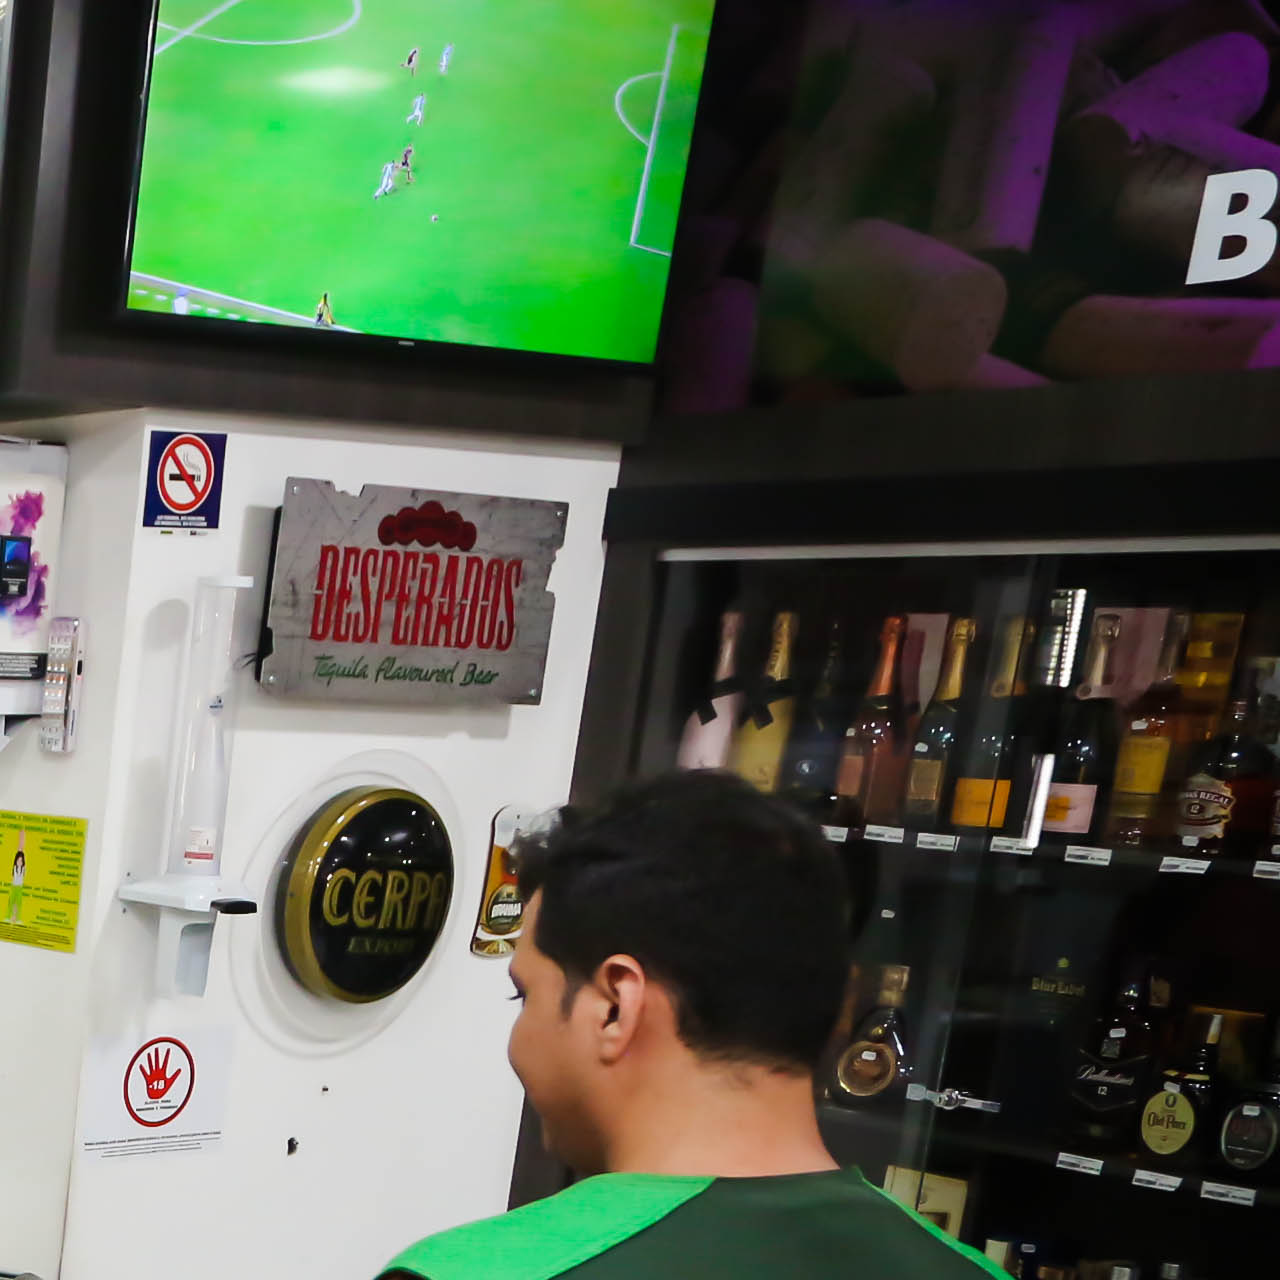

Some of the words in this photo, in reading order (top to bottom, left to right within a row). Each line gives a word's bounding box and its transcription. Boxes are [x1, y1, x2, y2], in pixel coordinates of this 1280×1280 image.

[308, 543, 523, 652] DESPERADOS
[313, 654, 368, 688] Tequila
[374, 656, 459, 684] Flavoured
[459, 662, 500, 687] Beer
[322, 867, 448, 930] CERPA
[1098, 1086, 1108, 1096] 12
